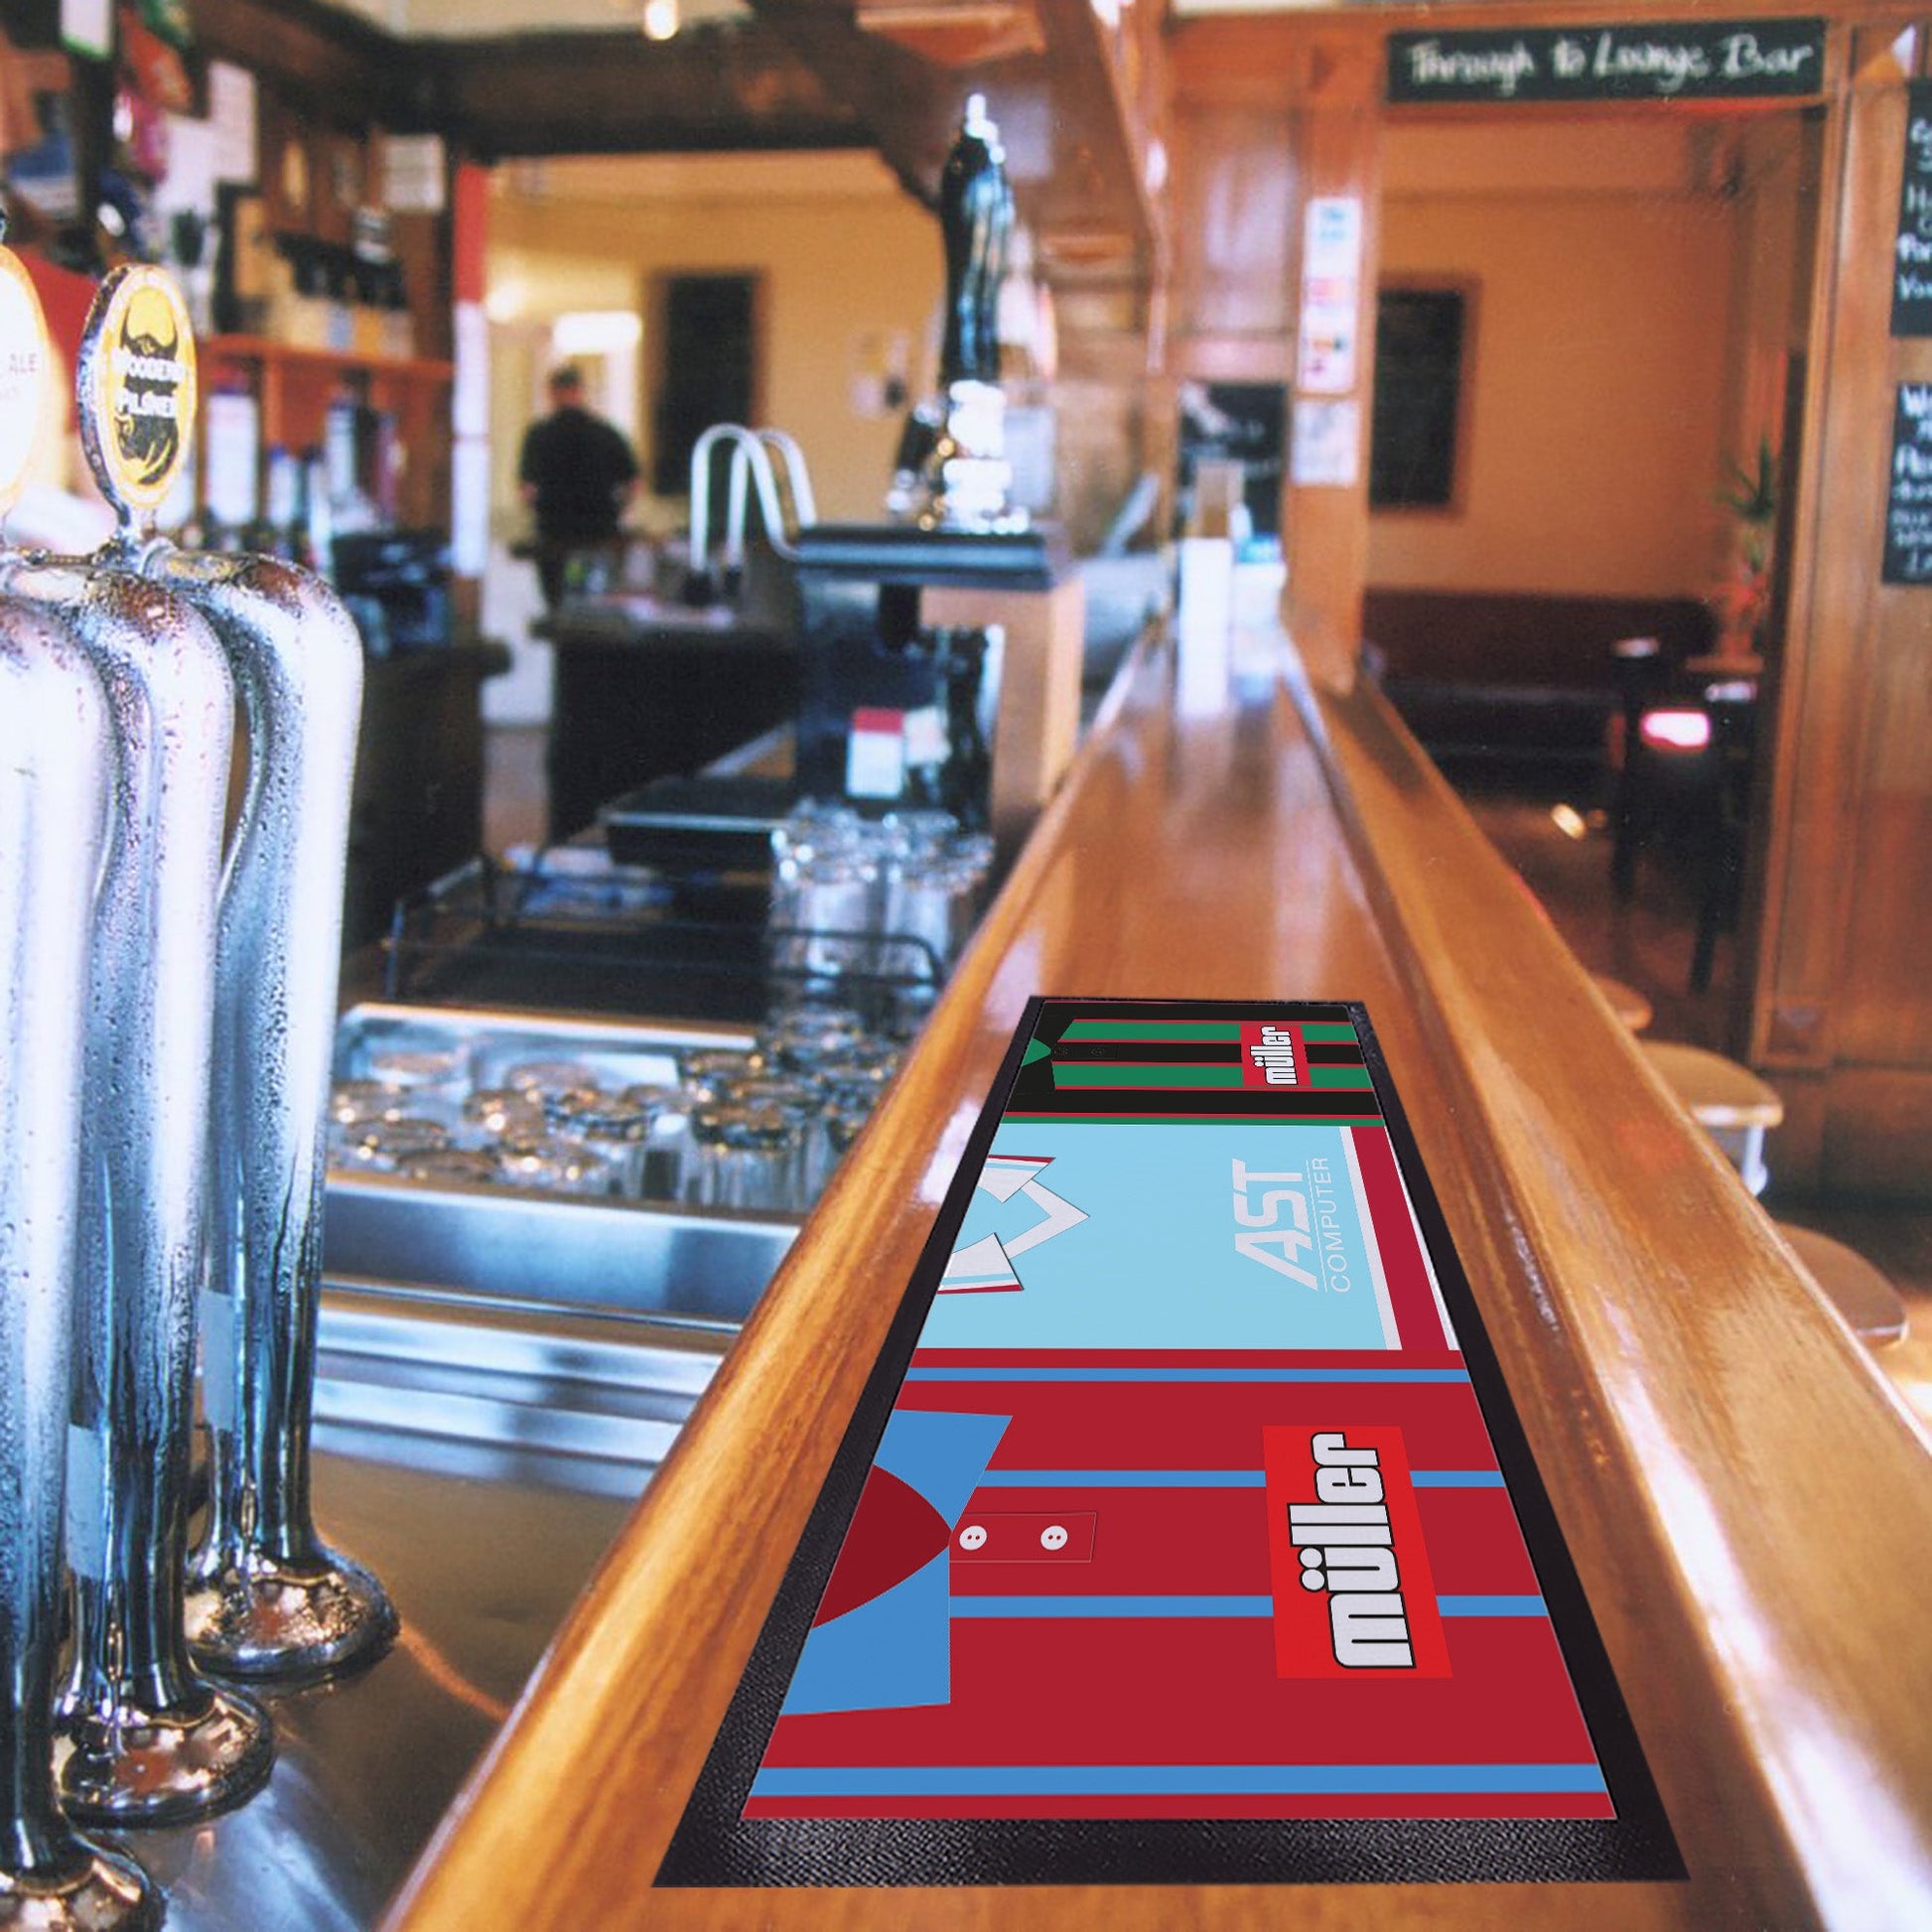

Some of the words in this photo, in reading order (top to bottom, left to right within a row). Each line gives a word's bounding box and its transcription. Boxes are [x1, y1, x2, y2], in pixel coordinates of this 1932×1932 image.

[1410, 38, 1535, 95] Through
[1553, 37, 1587, 78] to
[1722, 33, 1813, 79] Bar
[1250, 1026, 1298, 1085] müller
[1232, 1158, 1318, 1292] AST
[1311, 1157, 1351, 1293] COMPUTER
[1287, 1432, 1417, 1669] müller
